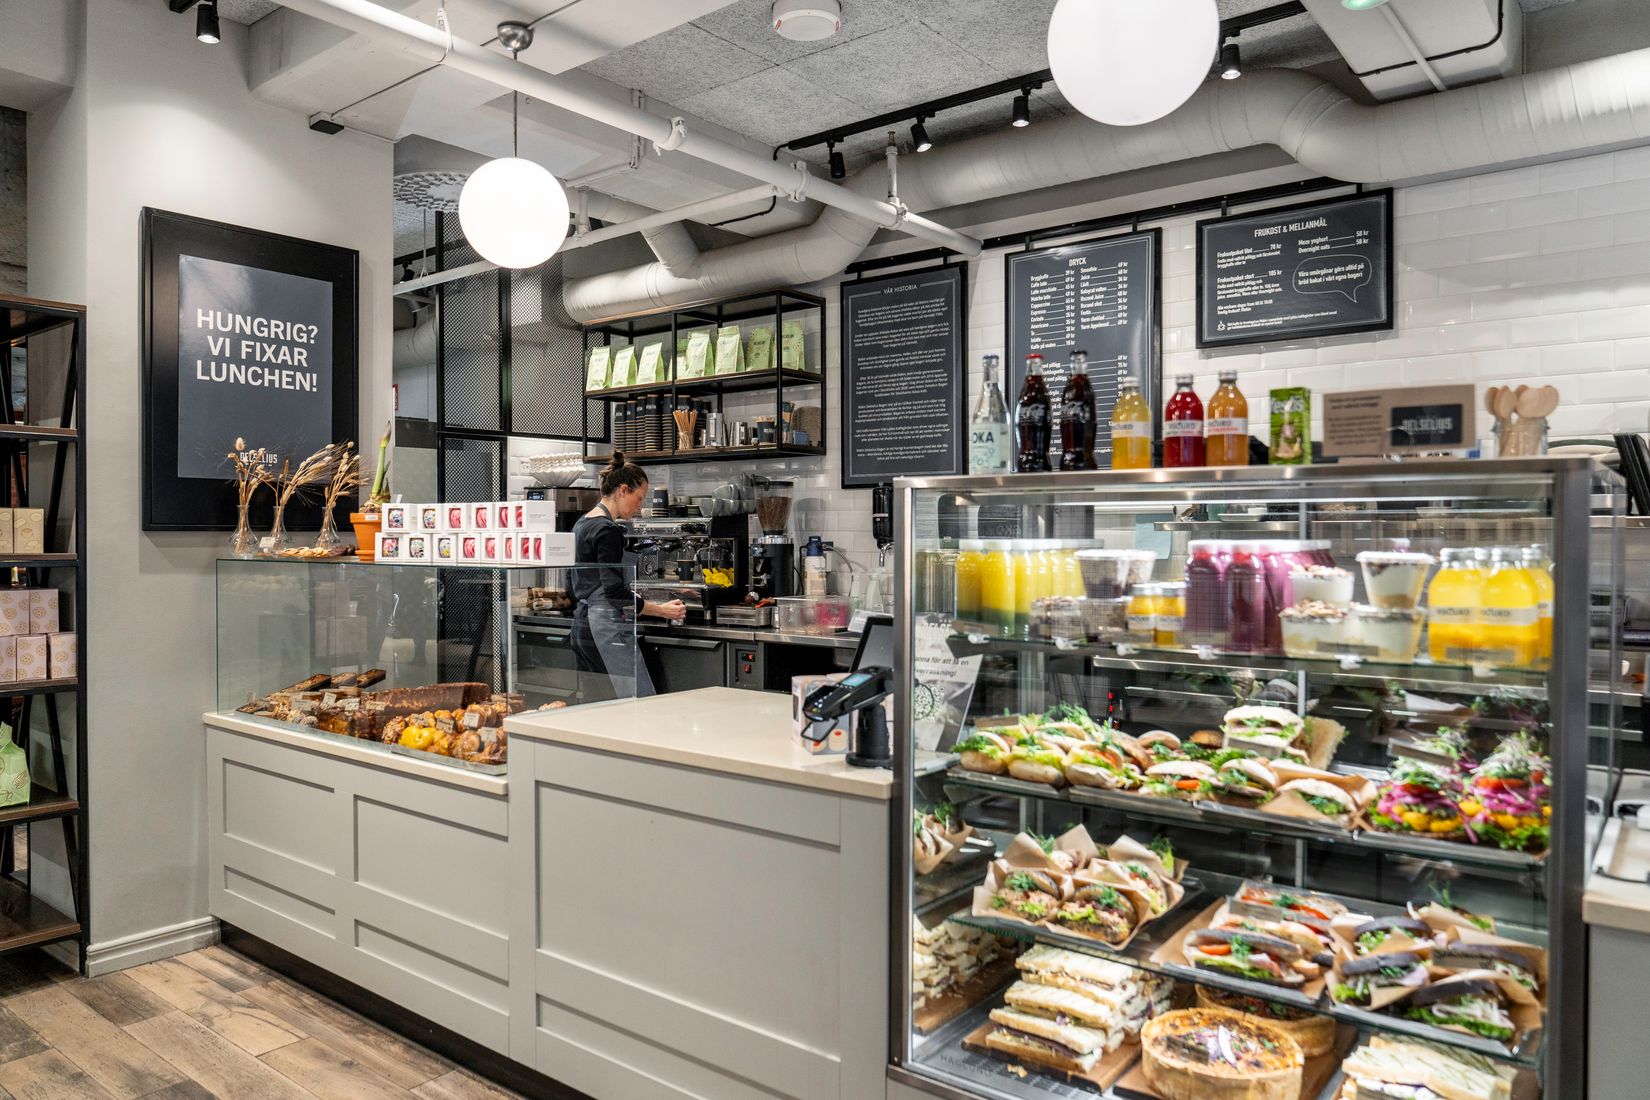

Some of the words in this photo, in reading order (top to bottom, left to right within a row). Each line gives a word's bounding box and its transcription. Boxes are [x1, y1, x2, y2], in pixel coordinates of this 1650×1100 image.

[1254, 226, 1281, 237] FRUKOST
[1289, 217, 1327, 232] MELLANMÅL
[1311, 236, 1328, 244] yoghurt
[1069, 257, 1086, 266] DRYCK
[894, 284, 917, 292] HISTORIA
[197, 308, 318, 344] HUNGRIG?
[208, 335, 230, 358] VI
[241, 341, 308, 367] FIXAR
[196, 360, 318, 392] LUNCHEN!
[972, 431, 994, 444] OKA
